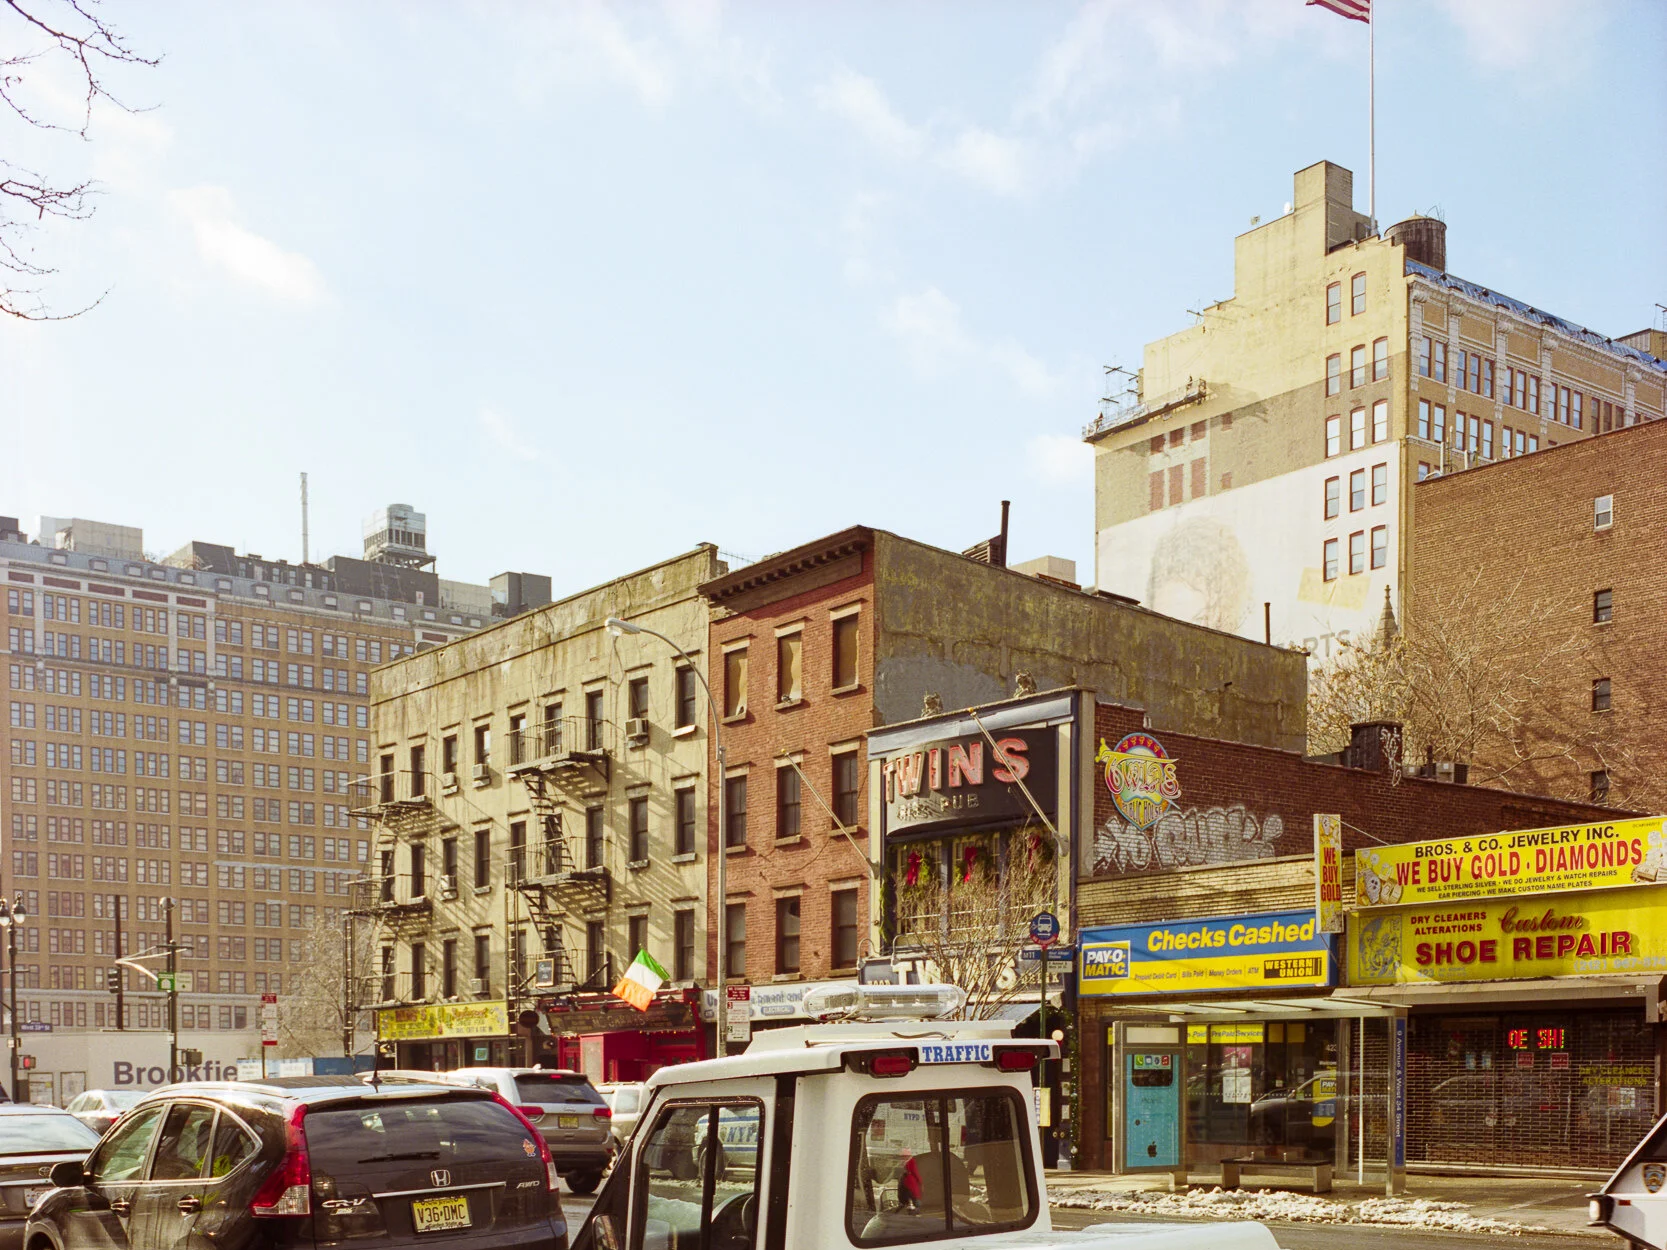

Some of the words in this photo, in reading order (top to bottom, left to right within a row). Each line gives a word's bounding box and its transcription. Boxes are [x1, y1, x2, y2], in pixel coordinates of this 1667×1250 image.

[883, 737, 1030, 803] TWINS
[1415, 843, 1458, 858] BROS.
[1463, 841, 1474, 853] &
[1478, 838, 1503, 851] CO.
[1508, 829, 1582, 849] JEWELRY
[1587, 826, 1620, 839] INC.
[1324, 847, 1336, 864] WE
[1396, 860, 1420, 886] WE
[1431, 857, 1464, 883] BUY
[1472, 852, 1521, 880] GOLD
[1535, 838, 1643, 874] DIAMONDS
[1323, 866, 1338, 883] BUY
[1443, 882, 1474, 891] STERLING
[1475, 880, 1496, 888] SILVER
[1525, 875, 1555, 884] JEWELRY
[1563, 872, 1587, 880] WATCH
[1589, 869, 1617, 878] REPAIRS
[1321, 884, 1341, 902] GOLD
[1452, 890, 1481, 898] PIERCING
[1518, 884, 1545, 892] CUSTOM
[1547, 882, 1566, 890] NAME
[1568, 880, 1593, 888] PLATES
[1411, 915, 1430, 925] DRY
[1434, 911, 1487, 924] CLEANERS
[1498, 906, 1583, 934] Custom
[1147, 927, 1226, 952] Checks
[1227, 918, 1316, 946] Cashed
[1414, 923, 1483, 936] ALTERATIONS
[1415, 939, 1497, 966] SHOE
[1513, 931, 1632, 961] REPAIR
[1265, 959, 1312, 970] WESTERN
[1279, 968, 1312, 977] UNION
[922, 1044, 990, 1063] TRAFFIC
[726, 1126, 758, 1142] NYP
[516, 1180, 541, 1190] AWD
